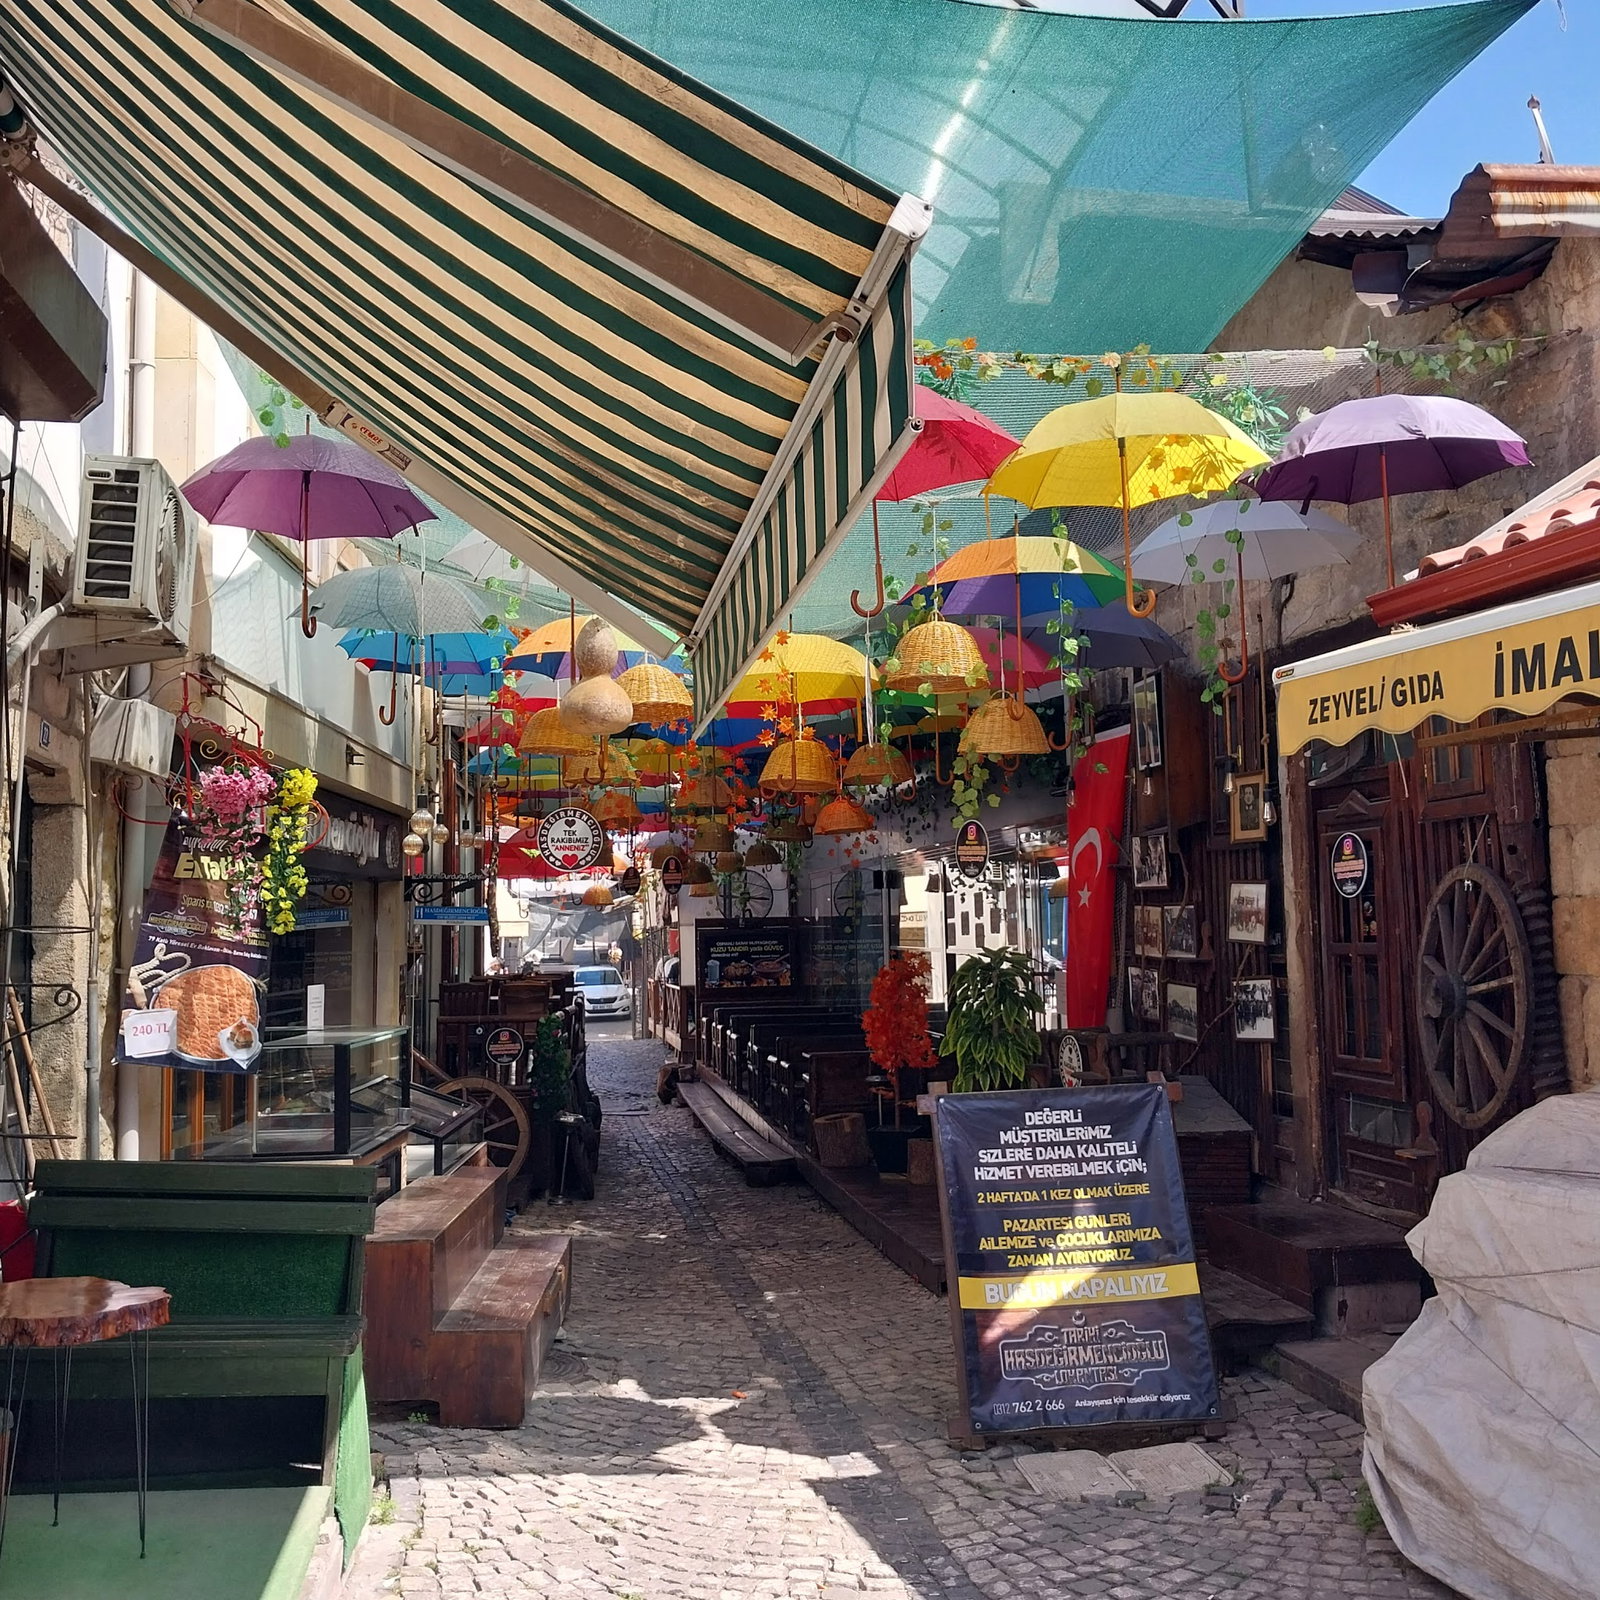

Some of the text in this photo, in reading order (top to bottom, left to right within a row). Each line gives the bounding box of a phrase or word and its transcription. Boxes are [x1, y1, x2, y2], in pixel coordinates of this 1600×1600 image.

[1308, 676, 1385, 725] ZEYVELİ
[1391, 671, 1444, 707] GIDA
[133, 1022, 170, 1036] 240 TL
[1036, 1145, 1075, 1160] DAHA
[977, 1192, 985, 1203] 2
[1041, 1190, 1047, 1201] 1
[1050, 1188, 1072, 1201] KEZ
[1073, 1185, 1112, 1200] OLMAK
[1114, 1182, 1150, 1197] ÜZERE
[1039, 1237, 1055, 1248] ve
[1056, 1226, 1162, 1250] ÇOCUKLARIMIZA
[1008, 1252, 1053, 1268] ZAMAN
[1063, 1272, 1169, 1300] KAPALIYIZ
[1012, 1400, 1034, 1413] 762
[1035, 1399, 1043, 1411] 2
[1045, 1399, 1065, 1411] 666
[1160, 1394, 1191, 1402] ediyoruz
